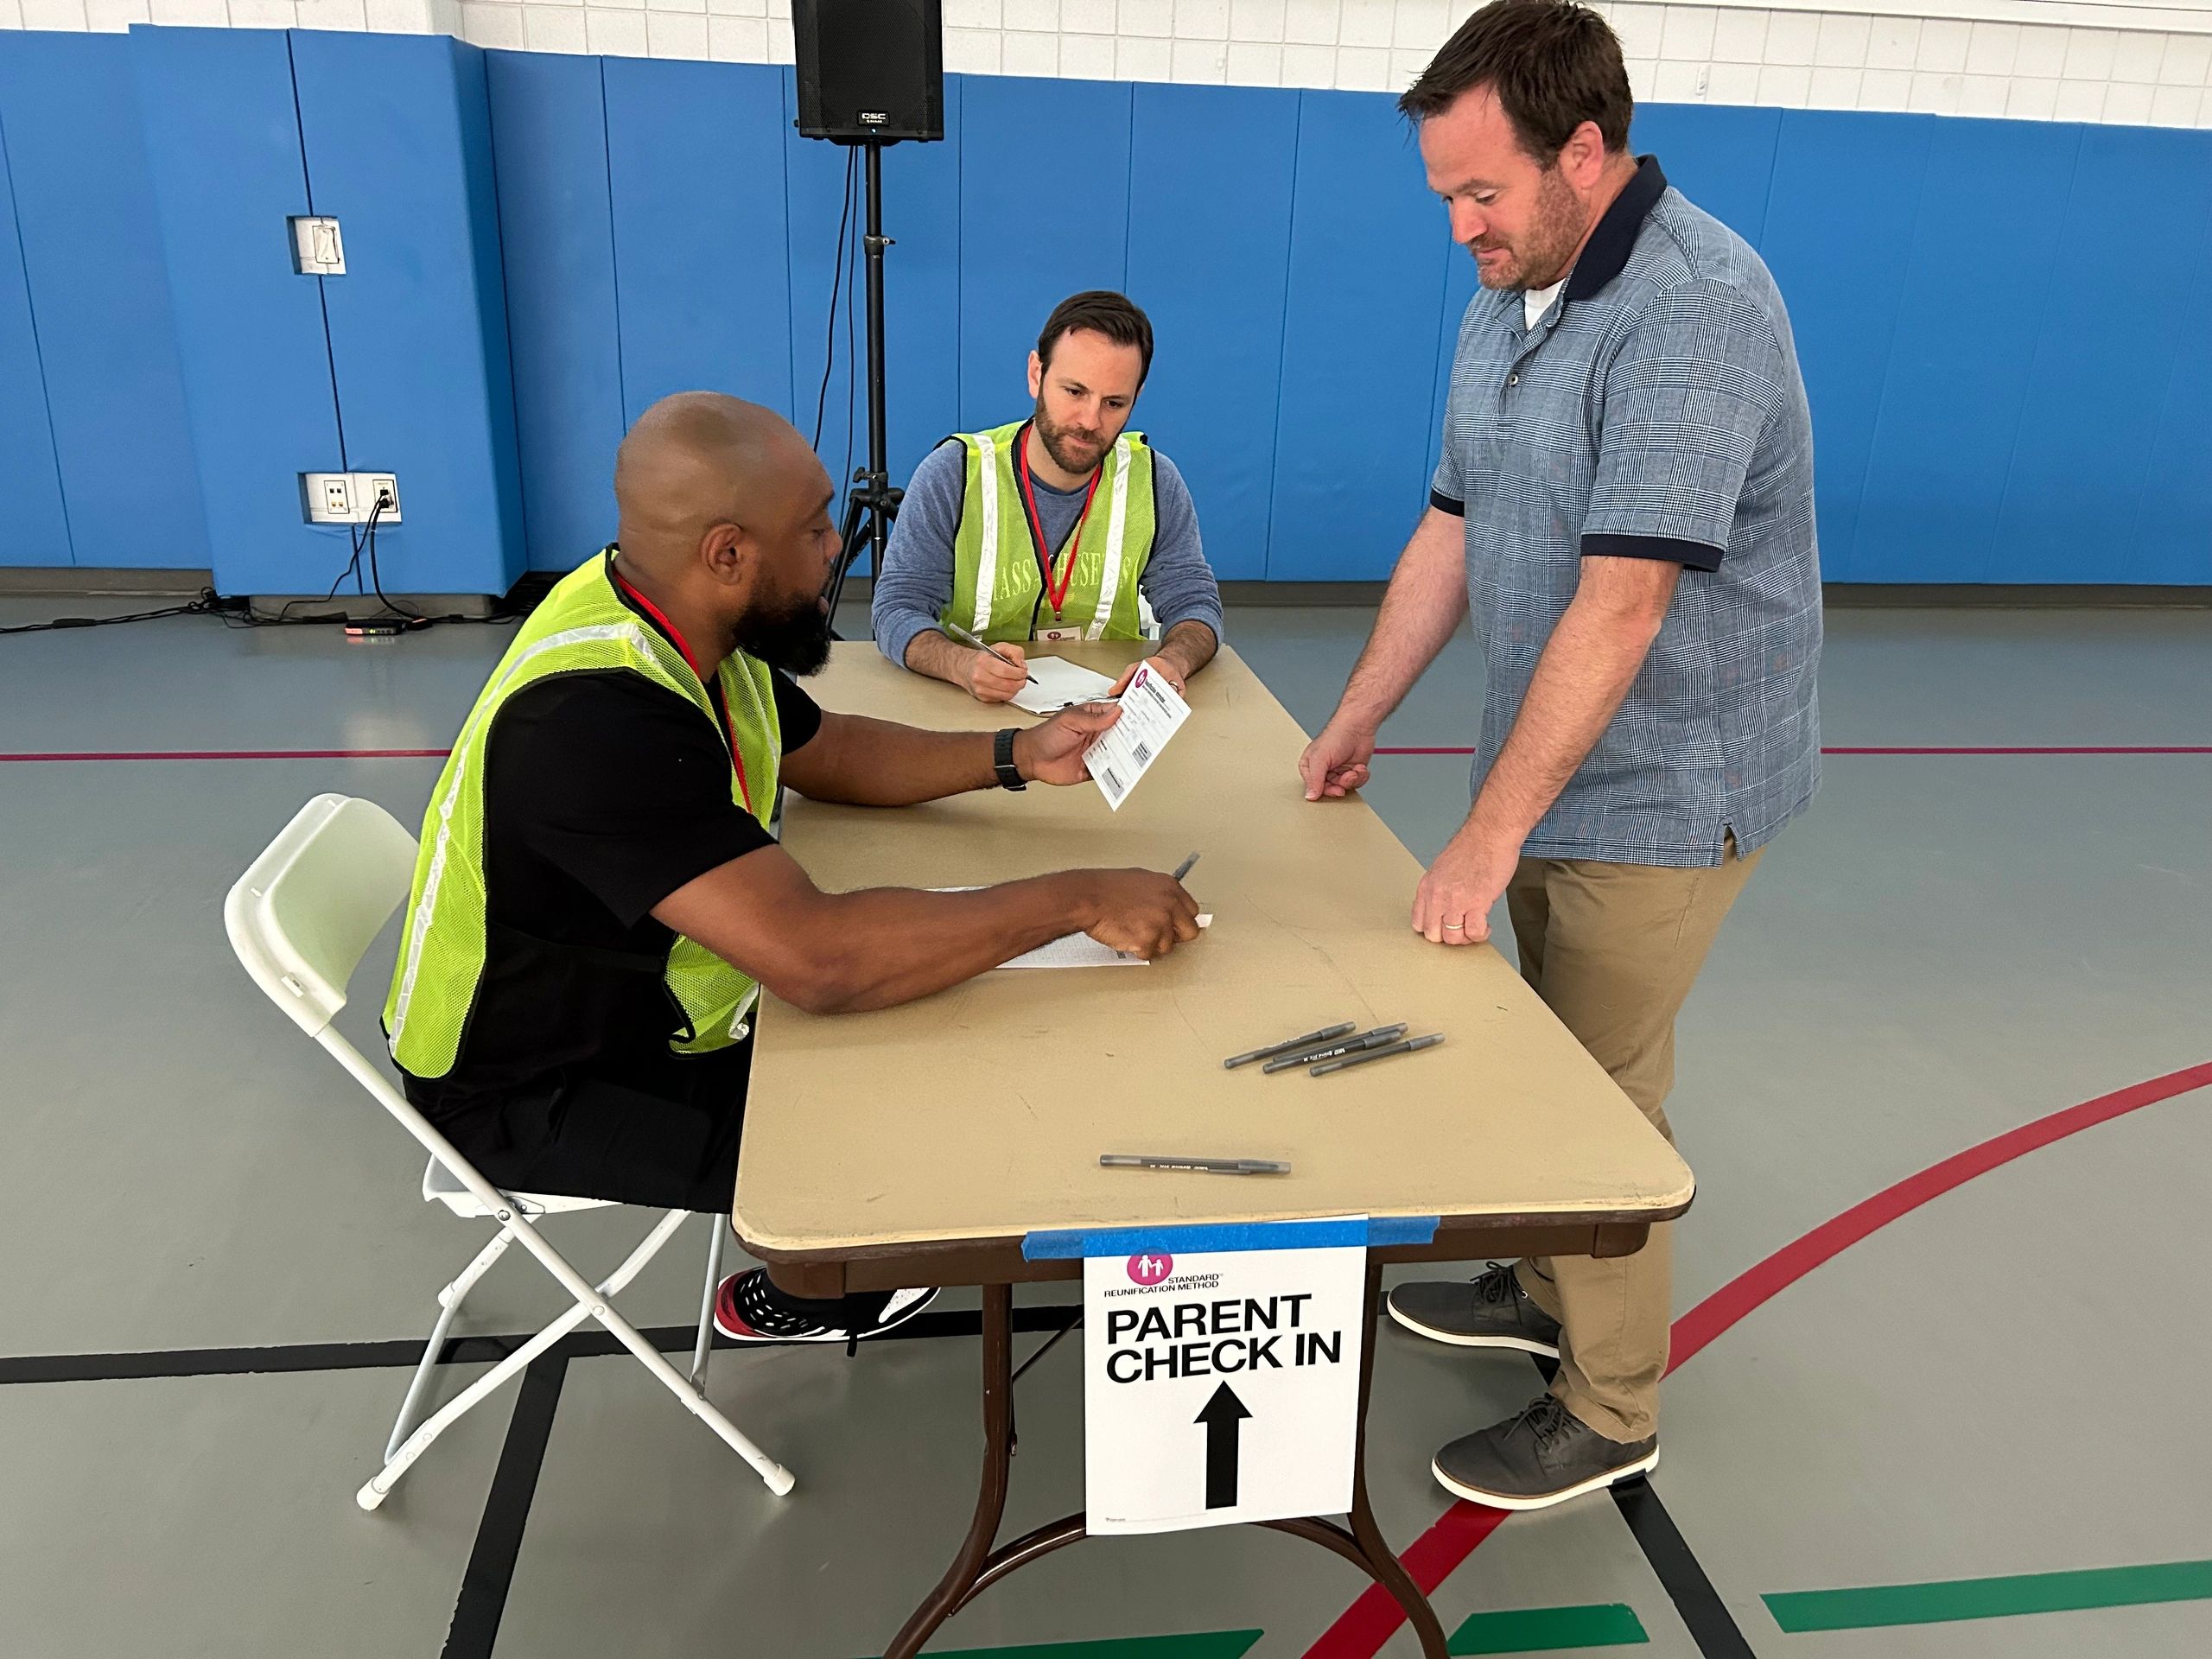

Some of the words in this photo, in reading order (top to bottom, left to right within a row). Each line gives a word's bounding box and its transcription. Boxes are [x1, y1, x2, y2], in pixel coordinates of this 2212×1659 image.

[1104, 1286, 1175, 1297] REUNIFICATION
[1178, 1281, 1219, 1290] METHOD
[1167, 1273, 1219, 1284] STANDARD
[1108, 1294, 1313, 1344] PARENT
[1106, 1335, 1283, 1383] CHECK
[1295, 1331, 1341, 1366] IN
